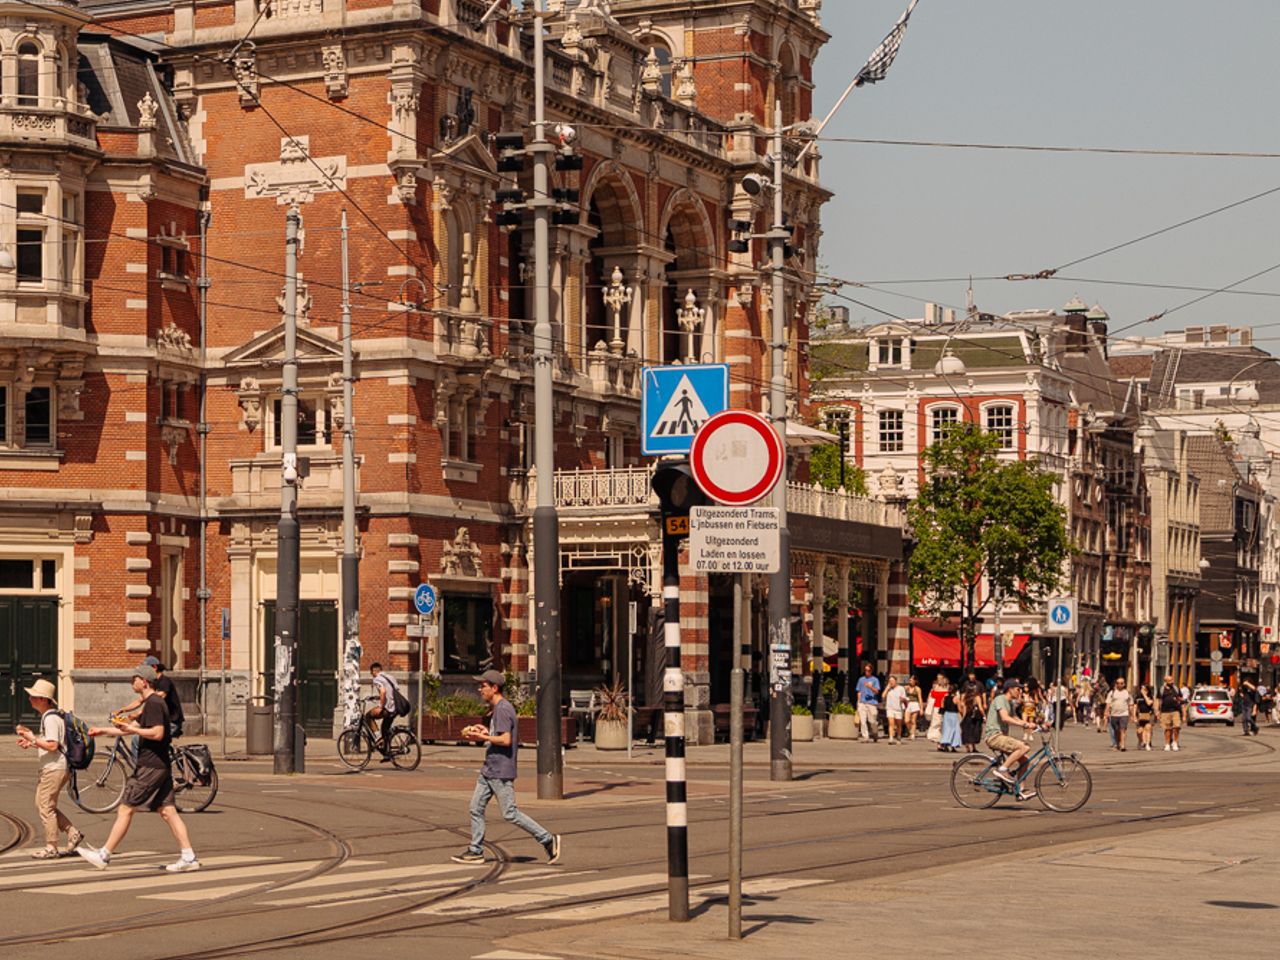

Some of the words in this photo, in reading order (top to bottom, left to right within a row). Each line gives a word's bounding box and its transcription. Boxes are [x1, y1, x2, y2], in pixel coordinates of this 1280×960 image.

[696, 508, 748, 520] Uitgezonderd
[750, 508, 777, 519] Trams,
[671, 519, 686, 531] 54
[691, 520, 733, 531] Ljnbussen
[735, 521, 745, 530] en
[746, 520, 778, 530] Fietsers
[705, 535, 759, 547] Uitgezonderd
[700, 549, 725, 559] Laden
[726, 551, 737, 559] en
[739, 550, 766, 560] lossen
[696, 560, 718, 570] 07.00
[732, 561, 754, 571] 12.00
[755, 562, 770, 571] uur
